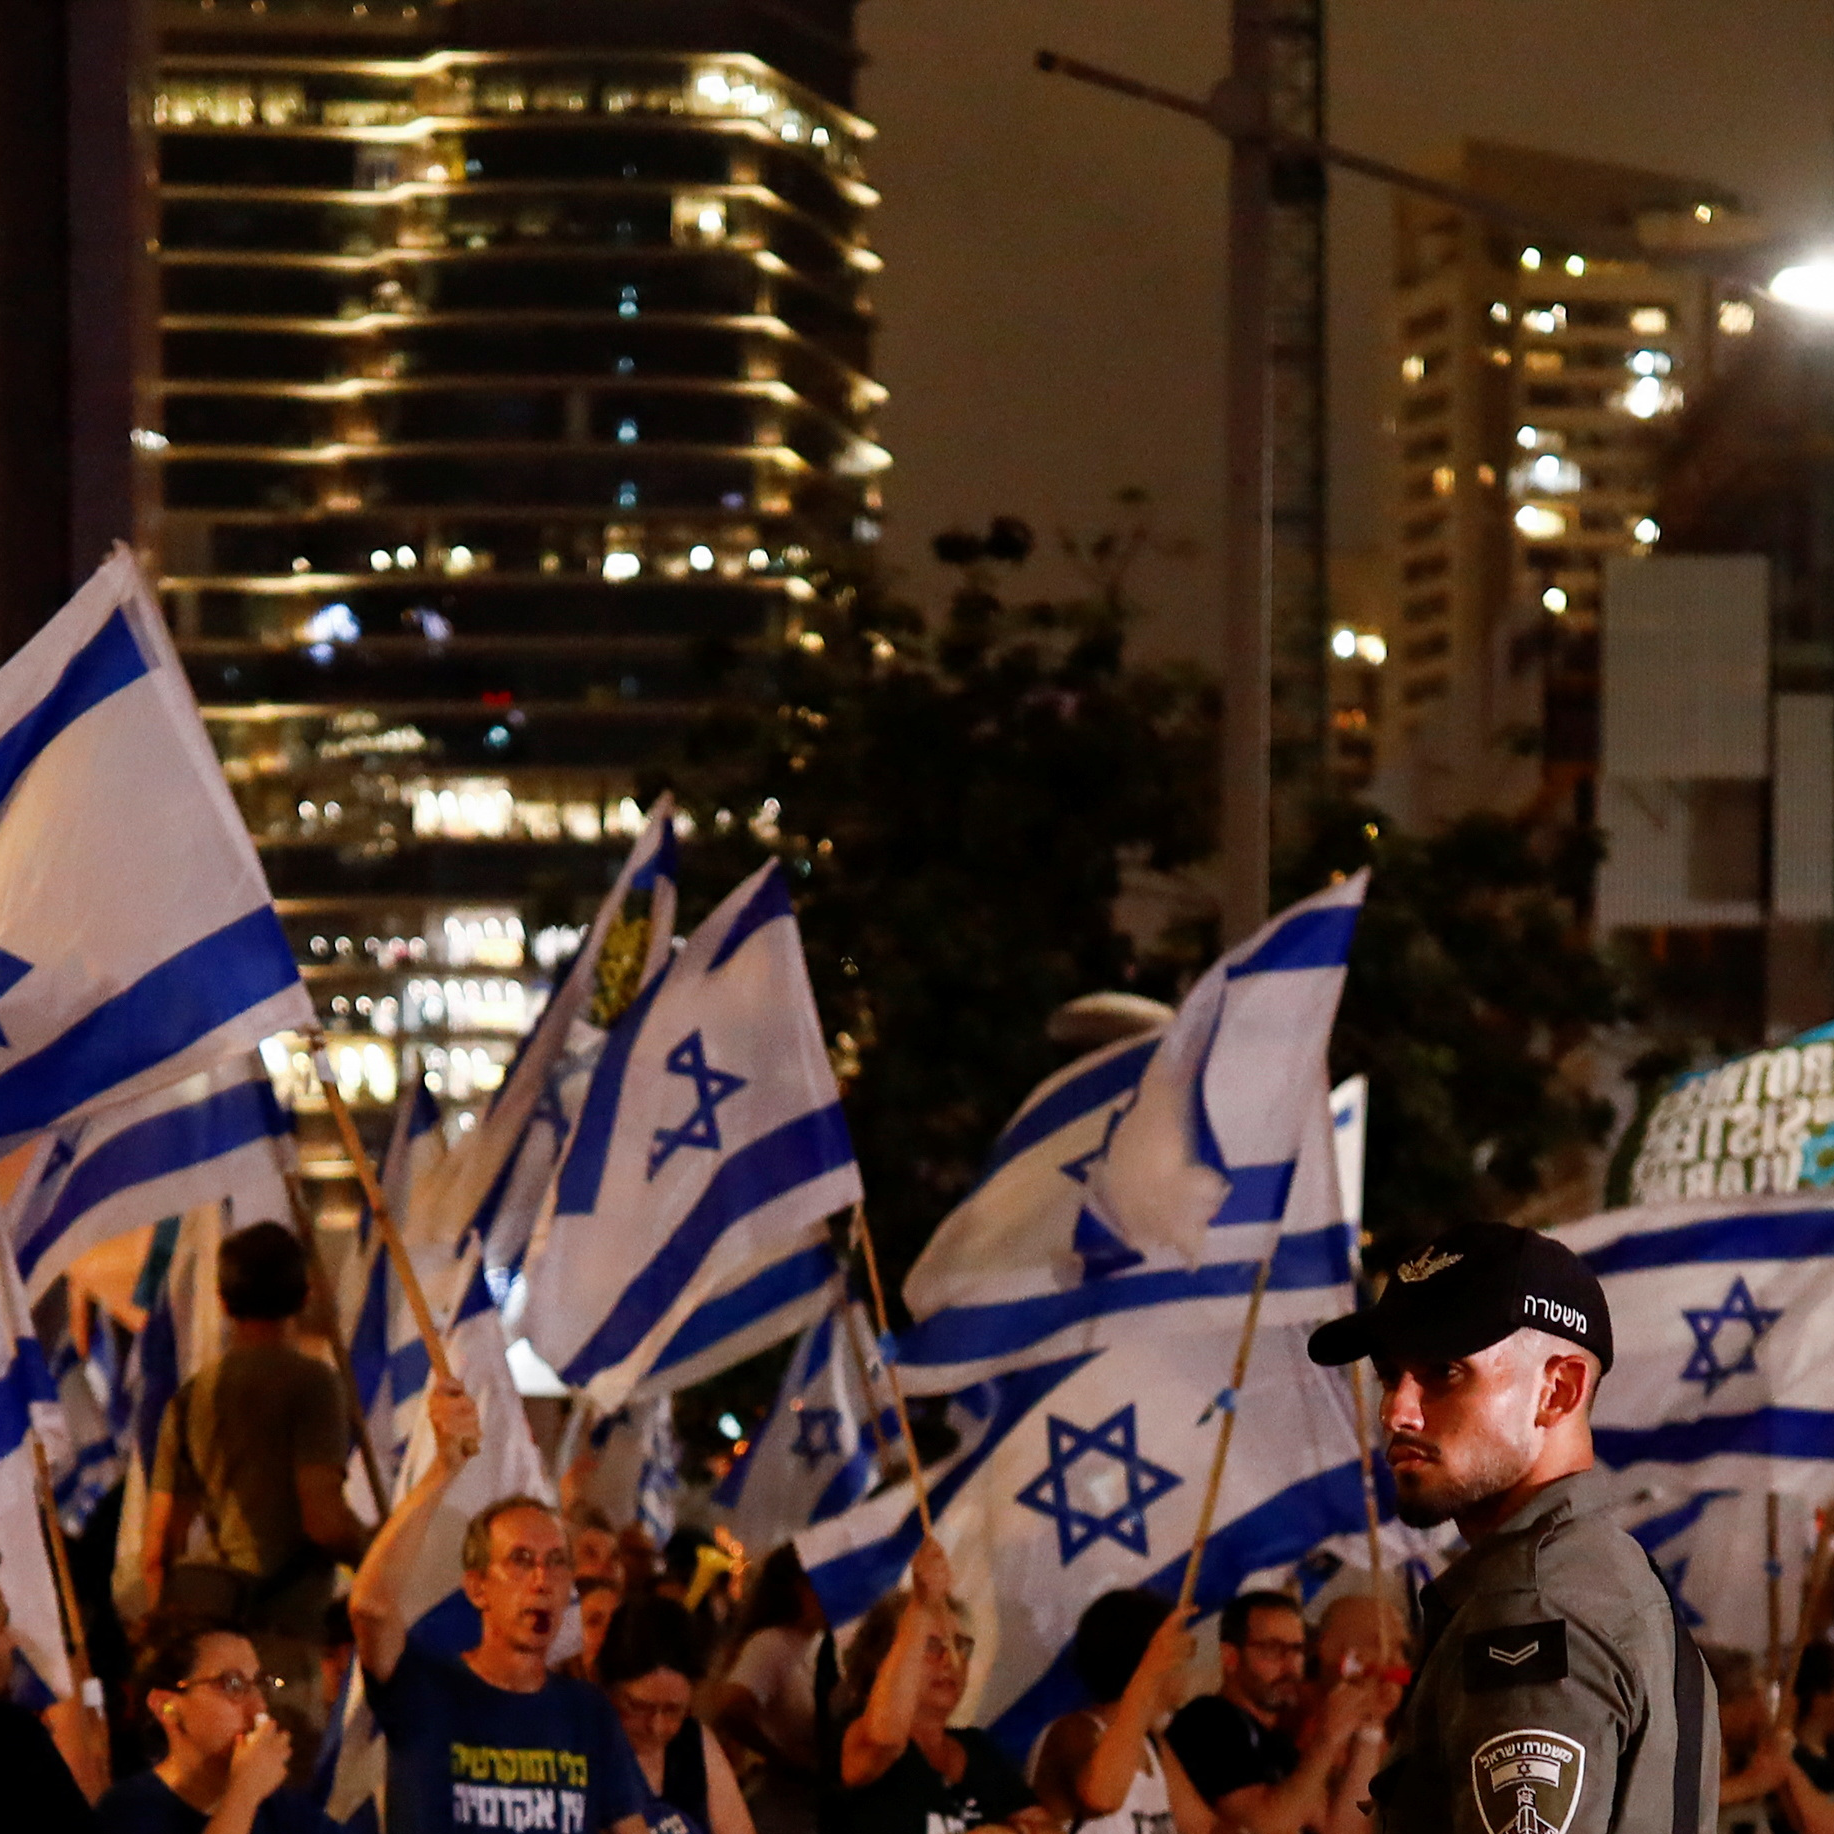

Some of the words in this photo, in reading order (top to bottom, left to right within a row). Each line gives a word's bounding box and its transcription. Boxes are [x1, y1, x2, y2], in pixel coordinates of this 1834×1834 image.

[1523, 1294, 1588, 1335] משטרה
[1478, 1741, 1522, 1770] ישראל
[1522, 1740, 1575, 1764] משטרת
